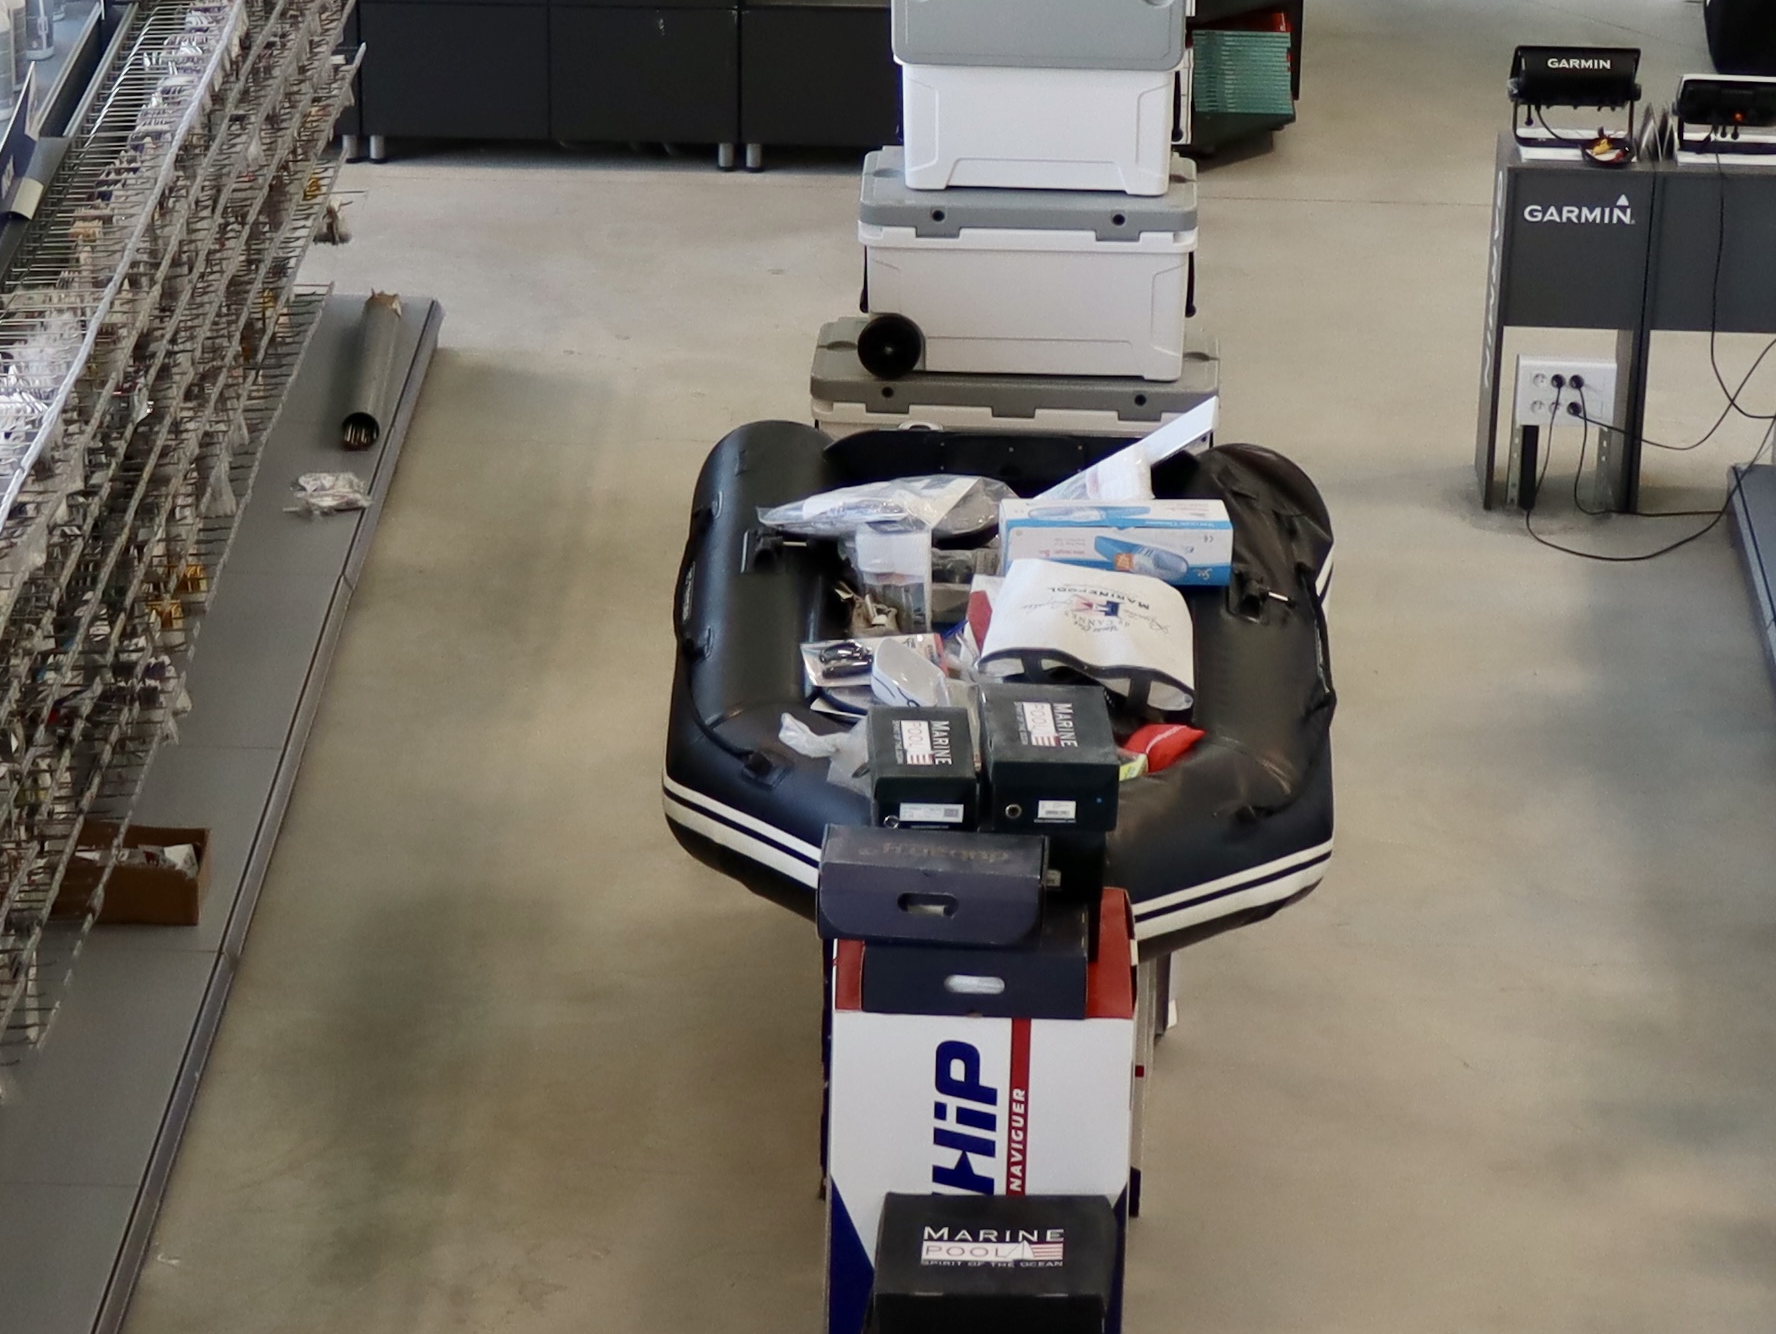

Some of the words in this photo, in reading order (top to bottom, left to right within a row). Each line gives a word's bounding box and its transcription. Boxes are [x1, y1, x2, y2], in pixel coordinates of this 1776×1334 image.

[1547, 58, 1611, 70] GARMIN
[1523, 204, 1632, 224] GARMIN
[1047, 586, 1151, 610] MARINEPOOL
[1053, 702, 1079, 748] MARINE
[930, 720, 953, 765] MARINE
[1010, 1087, 1026, 1192] NAVIGUER
[924, 1225, 1064, 1242] MARINE
[925, 1245, 1009, 1258] POOL
[922, 1259, 962, 1268] SPIRIT
[967, 1260, 983, 1268] OF
[988, 1260, 1015, 1269] THE
[1020, 1260, 1064, 1268] OCEAN
